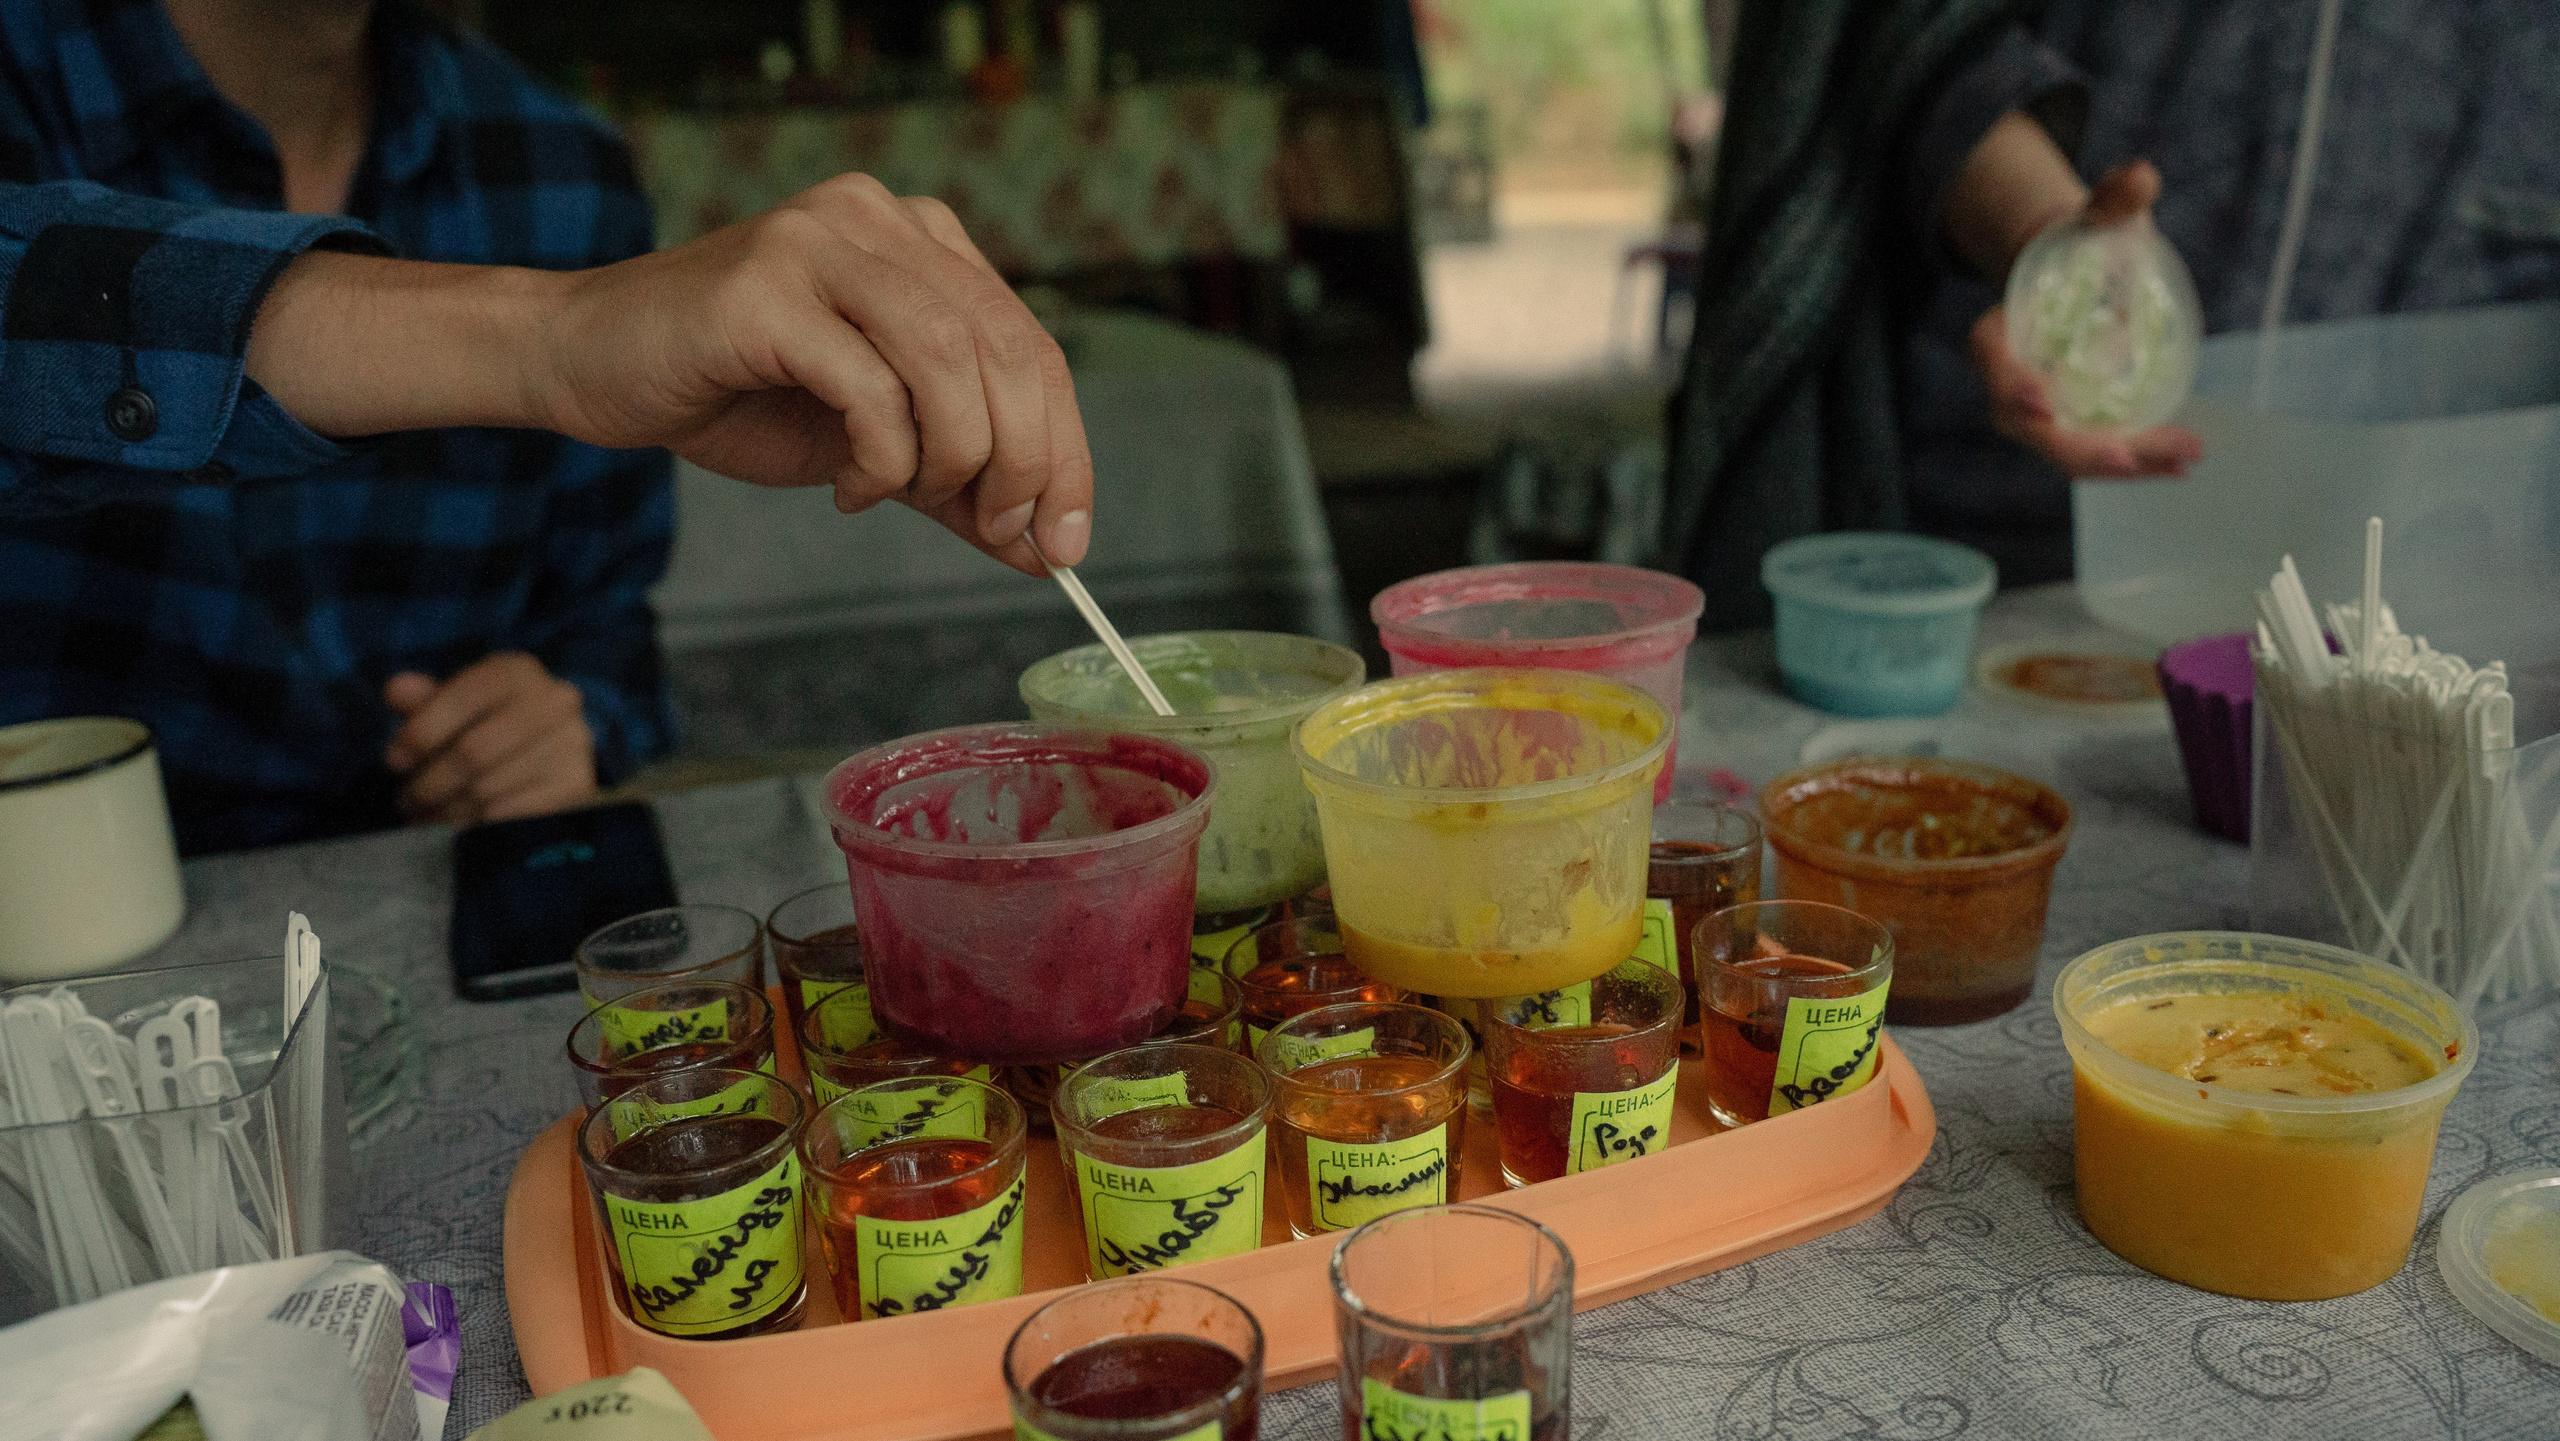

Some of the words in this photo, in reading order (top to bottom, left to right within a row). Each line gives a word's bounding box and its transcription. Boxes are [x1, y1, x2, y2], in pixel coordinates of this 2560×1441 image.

[1806, 1005, 1862, 1026] ЦЕНА
[1599, 1093, 1654, 1118] ЦЕНА:
[1594, 1123, 1657, 1159] Роза
[1332, 1150, 1396, 1170] ЦЕНА:
[1089, 1166, 1155, 1194] ЦЕНА
[620, 1206, 688, 1230] ЦЕНА
[876, 1229, 949, 1250] ЦЕНА
